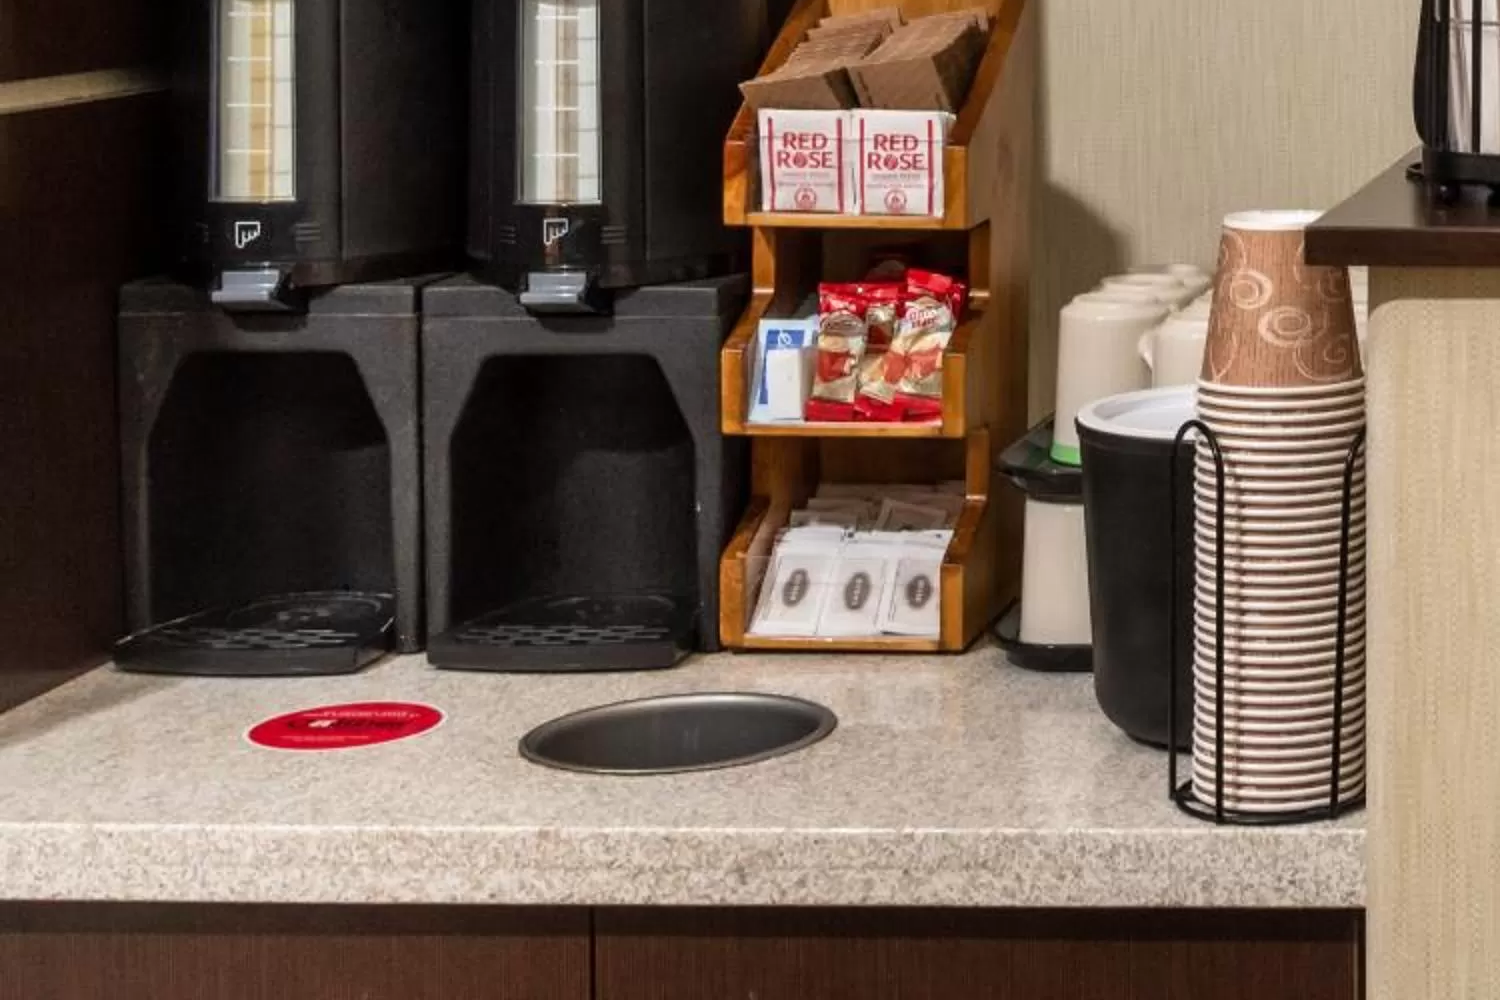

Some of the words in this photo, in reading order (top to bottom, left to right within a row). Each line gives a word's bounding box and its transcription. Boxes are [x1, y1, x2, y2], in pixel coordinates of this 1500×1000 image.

[782, 132, 828, 150] RED
[873, 133, 919, 151] RED
[776, 151, 836, 169] ROSE
[867, 152, 926, 171] ROSE
